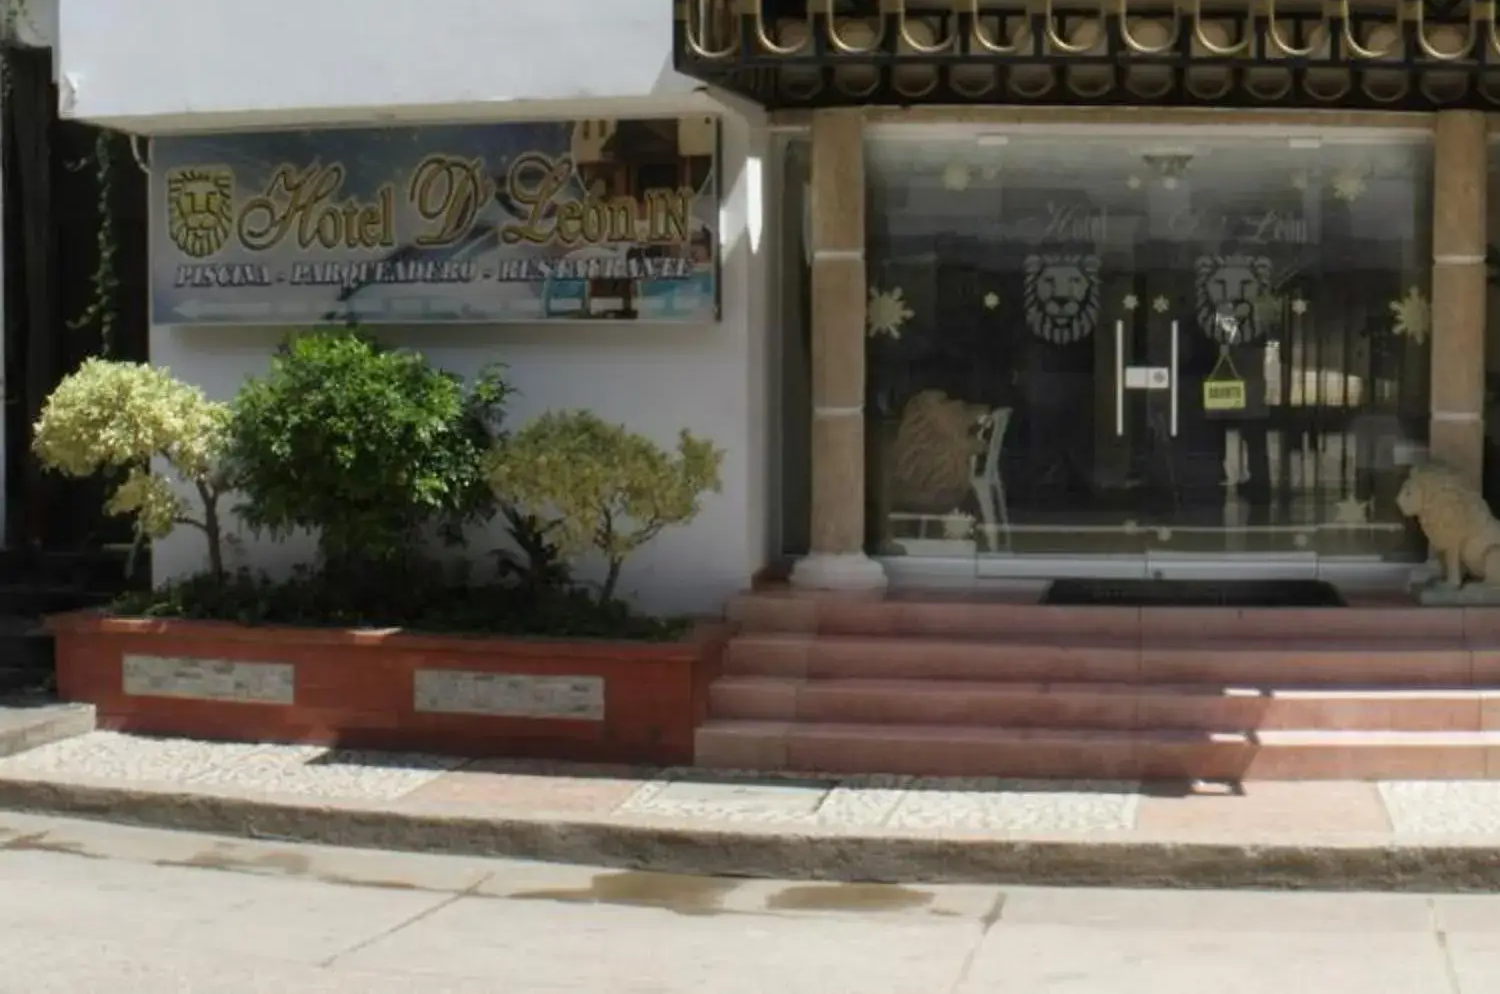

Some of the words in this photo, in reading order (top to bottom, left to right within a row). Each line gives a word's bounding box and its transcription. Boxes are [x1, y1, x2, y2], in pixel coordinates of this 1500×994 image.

[237, 165, 394, 251] Hotel
[175, 263, 272, 287] PISCINA
[290, 259, 476, 287] PARQUEADERO
